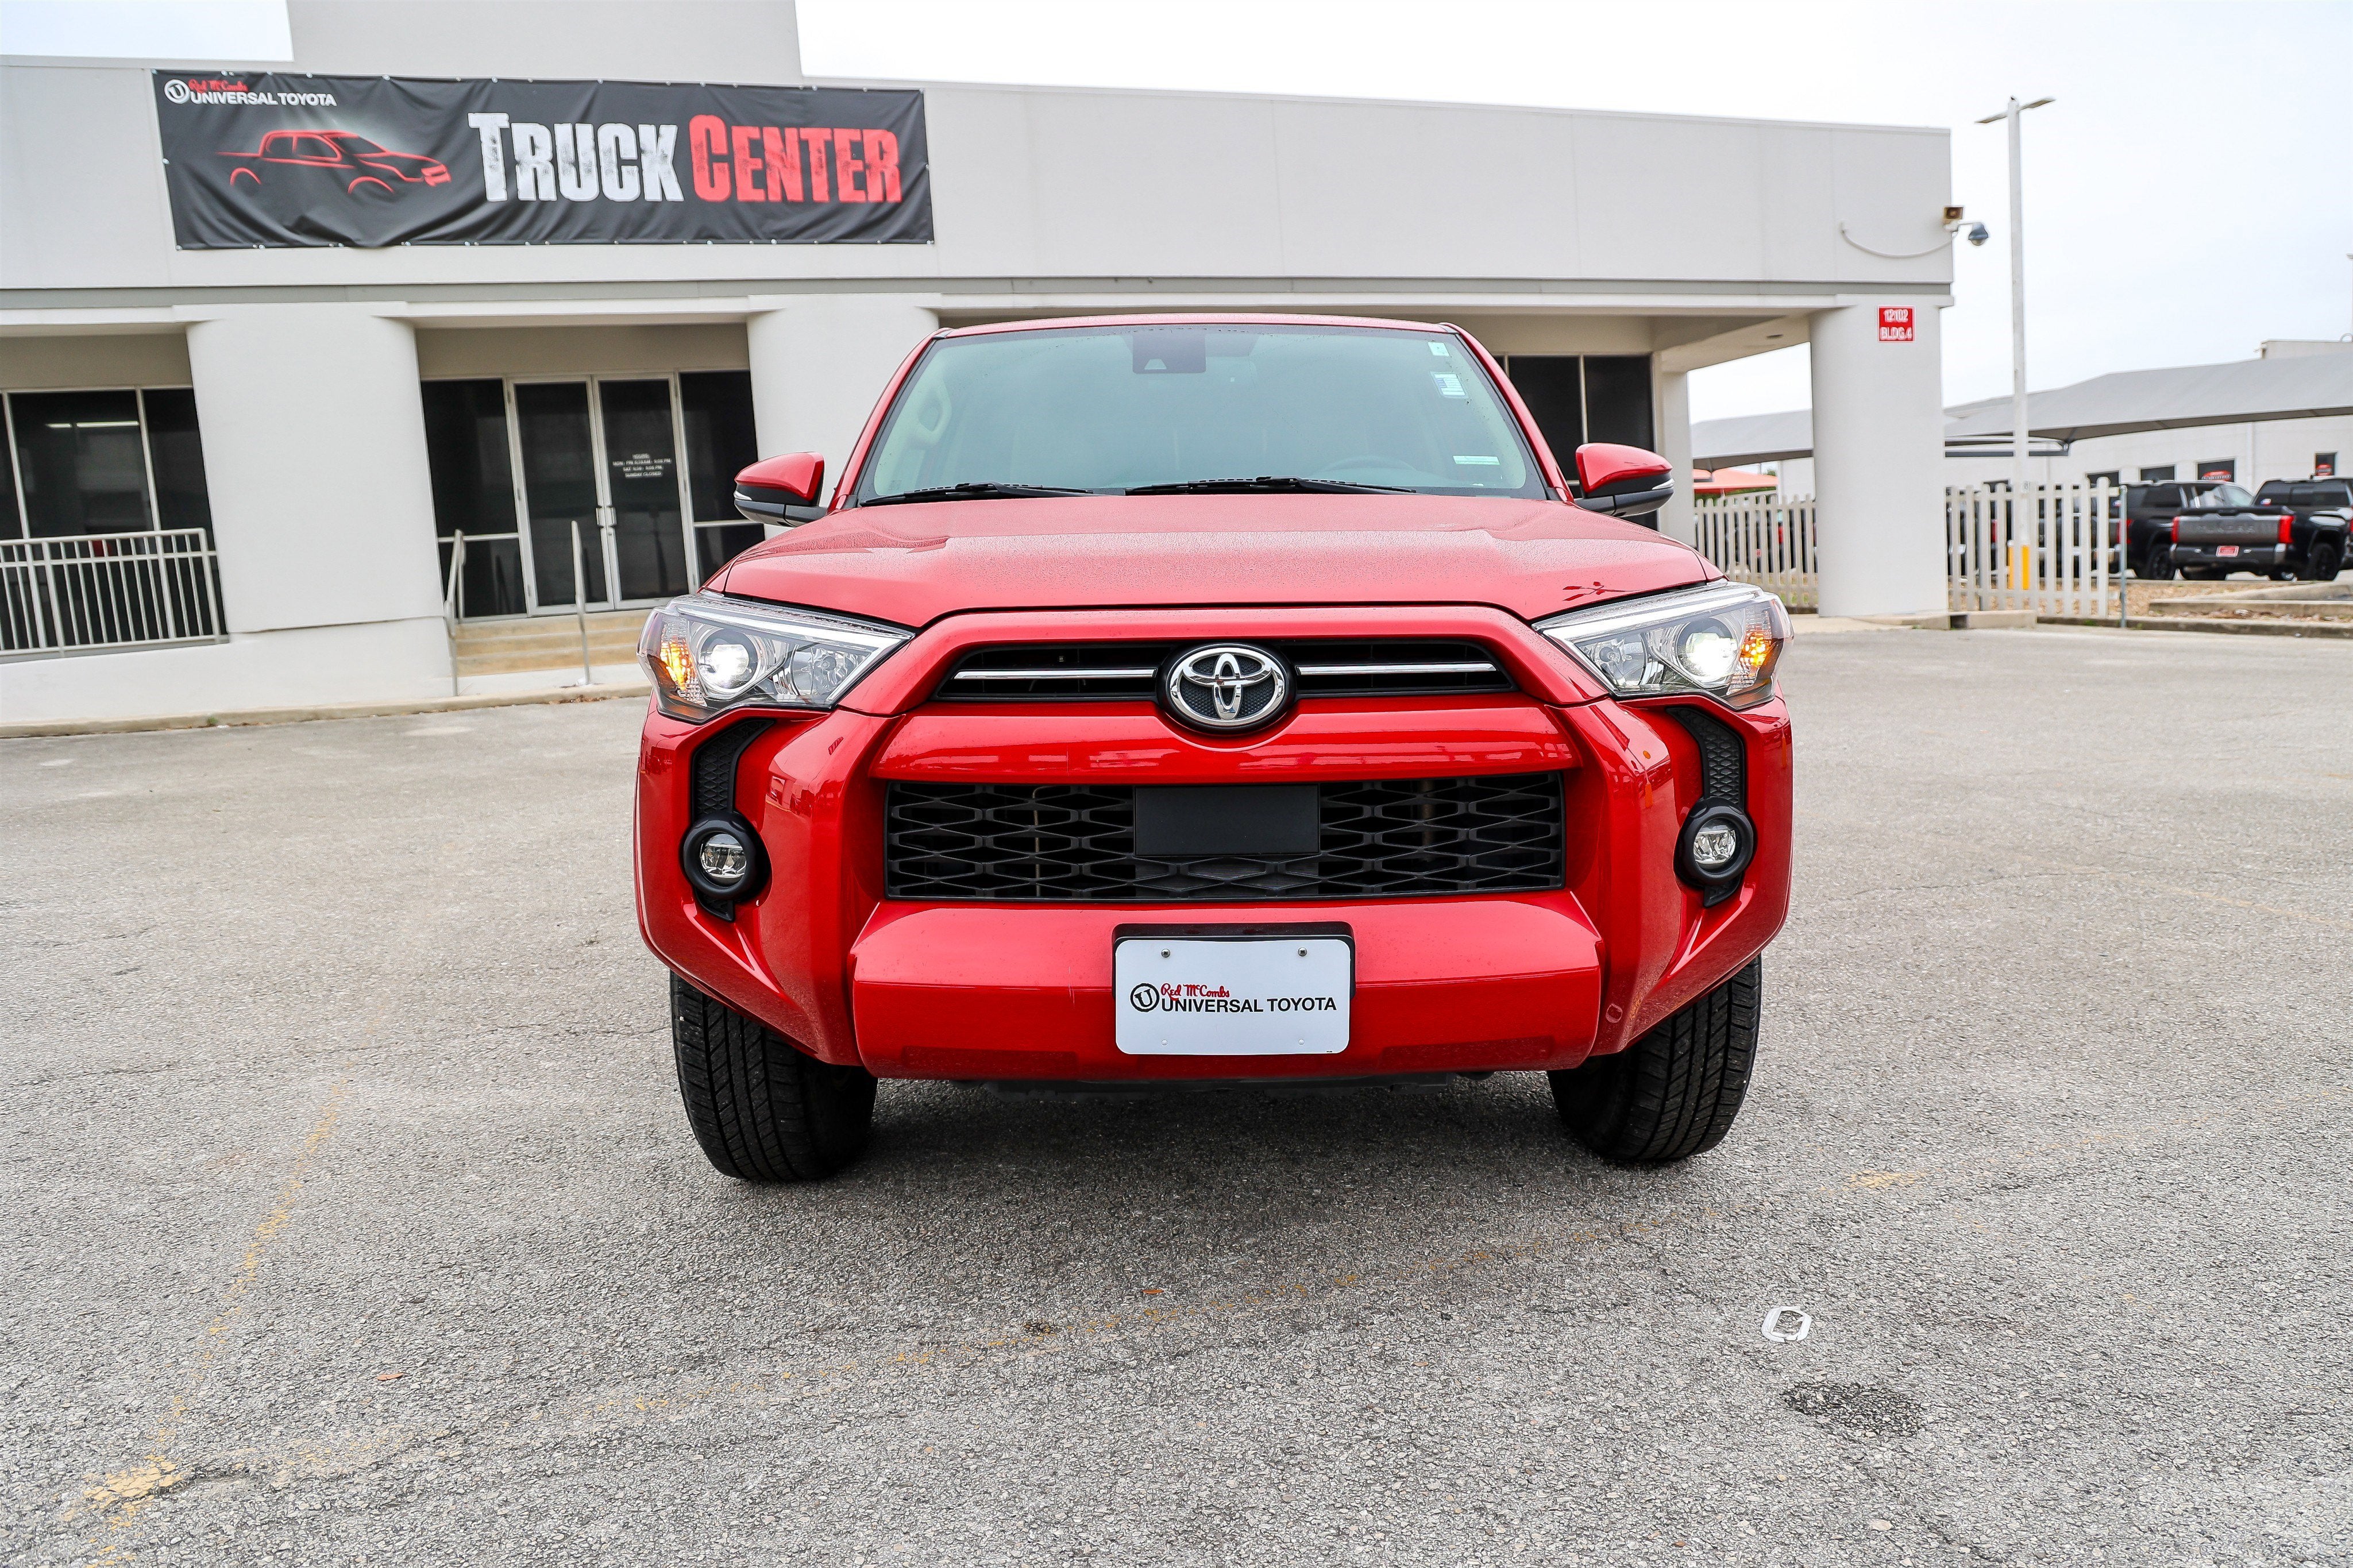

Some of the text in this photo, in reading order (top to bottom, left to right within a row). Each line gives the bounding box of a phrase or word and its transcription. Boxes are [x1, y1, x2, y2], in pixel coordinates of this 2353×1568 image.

[190, 91, 338, 106] UNIVERSAL TOYOTA
[468, 113, 902, 203] TRUCK CENTER
[1160, 983, 1230, 1001] Red McCombs
[1161, 997, 1337, 1013] UNIVERSAL TOYOTA
